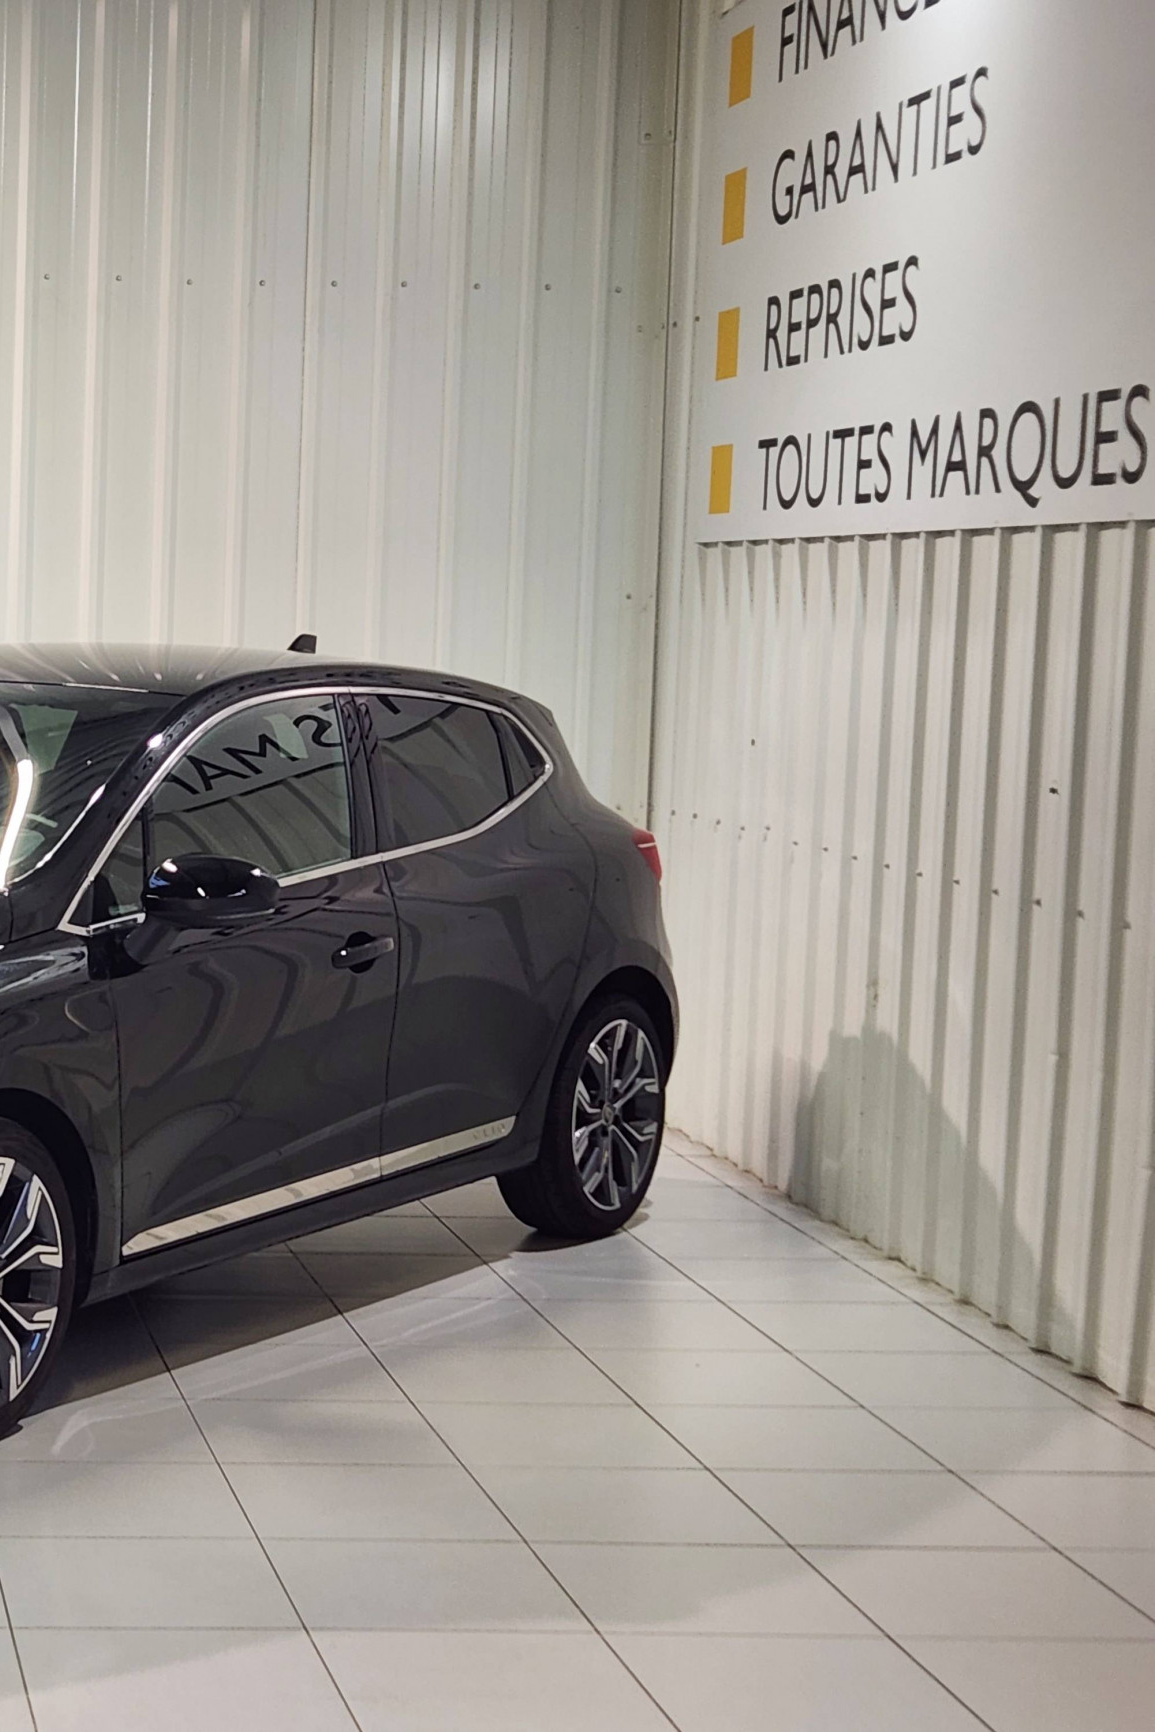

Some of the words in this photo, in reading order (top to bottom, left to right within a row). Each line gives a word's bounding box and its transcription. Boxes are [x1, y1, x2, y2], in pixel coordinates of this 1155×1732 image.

[778, 0, 940, 83] FINA
[771, 66, 989, 226] GARANTIES
[763, 255, 919, 372] REPRISES
[757, 421, 893, 511] TOUTES
[906, 384, 1151, 509] MARQUES
